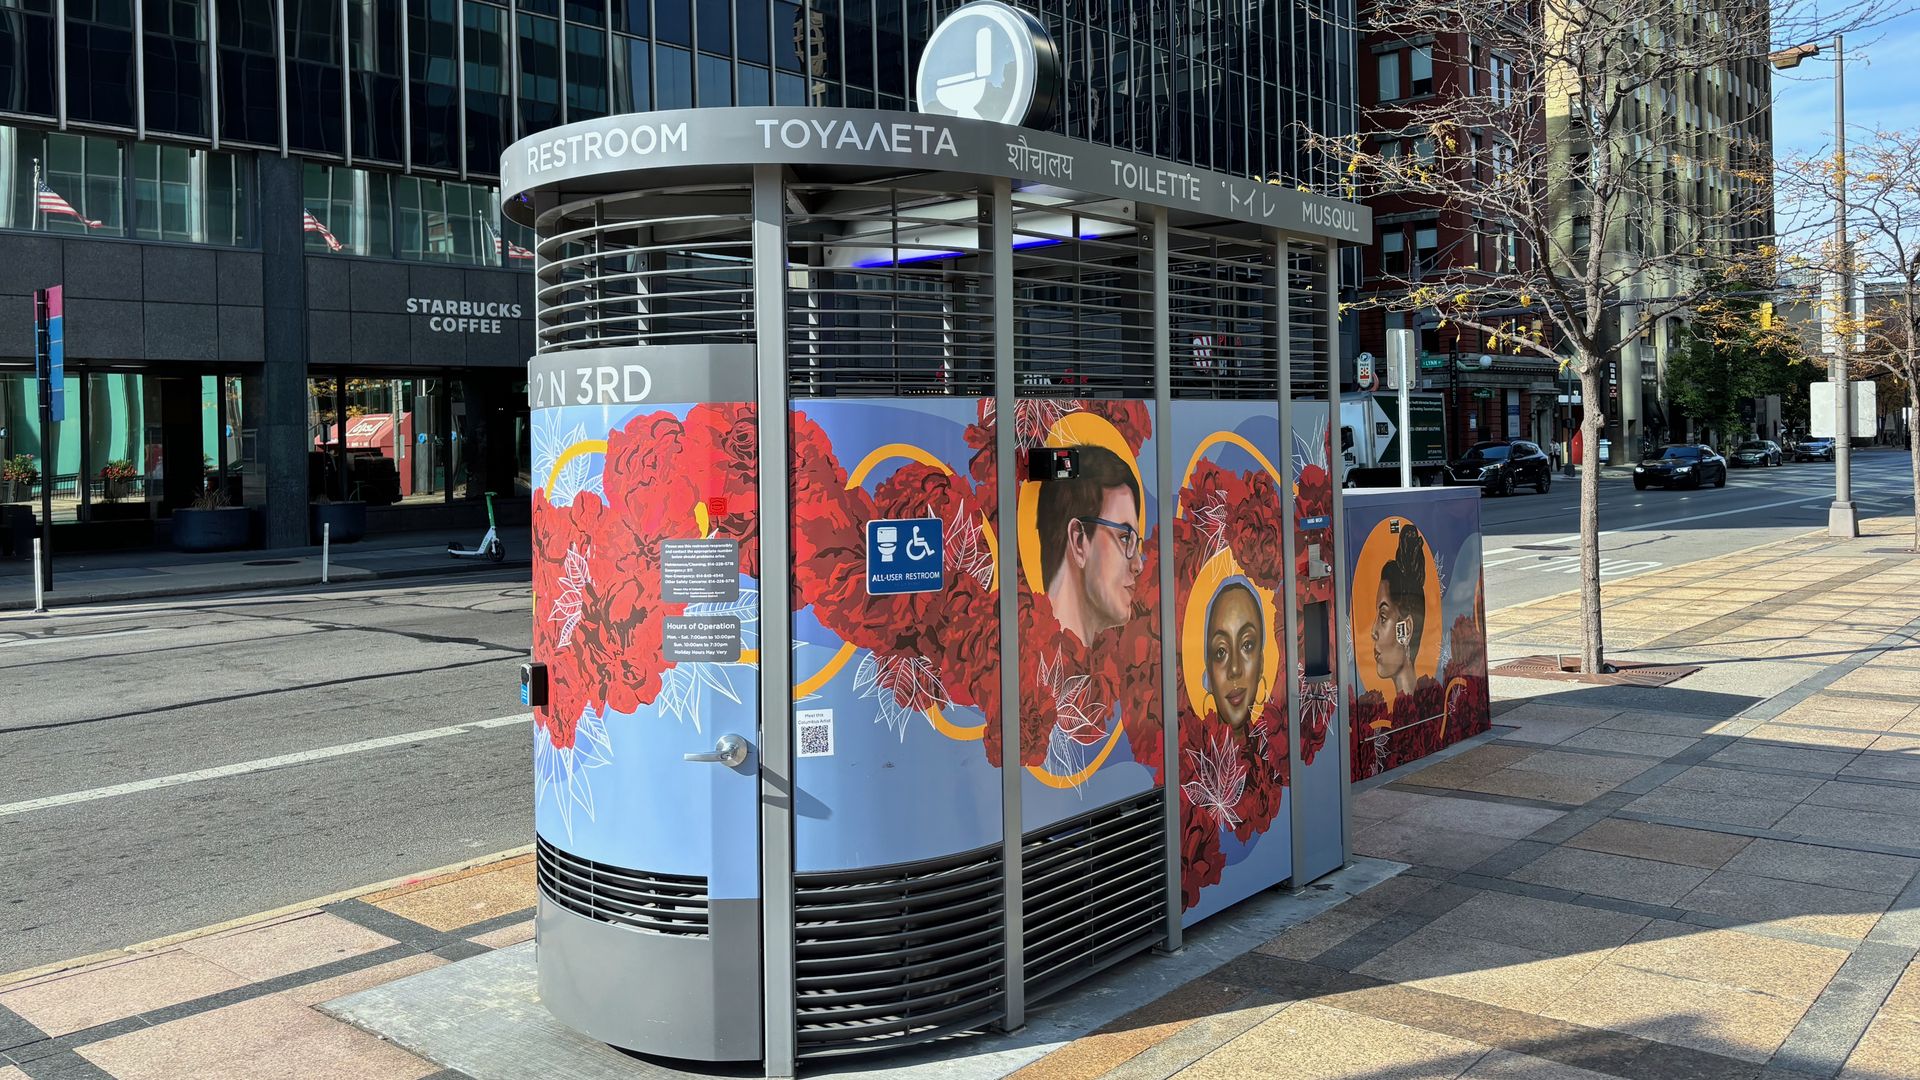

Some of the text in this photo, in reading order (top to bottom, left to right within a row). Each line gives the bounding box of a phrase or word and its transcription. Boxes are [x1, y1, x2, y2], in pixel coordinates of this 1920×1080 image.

[528, 122, 687, 175] RESTROOM
[1006, 134, 1074, 180] शौचालय
[1110, 160, 1200, 201] TOILETTE
[1230, 184, 1275, 218] トイレ
[1302, 202, 1358, 232] MUSQUL
[406, 298, 522, 318] STARBUCKS
[430, 316, 501, 334] COFFEE
[536, 365, 652, 408] 2 N 3RD
[872, 572, 940, 582] ALL-USER RESTROOM
